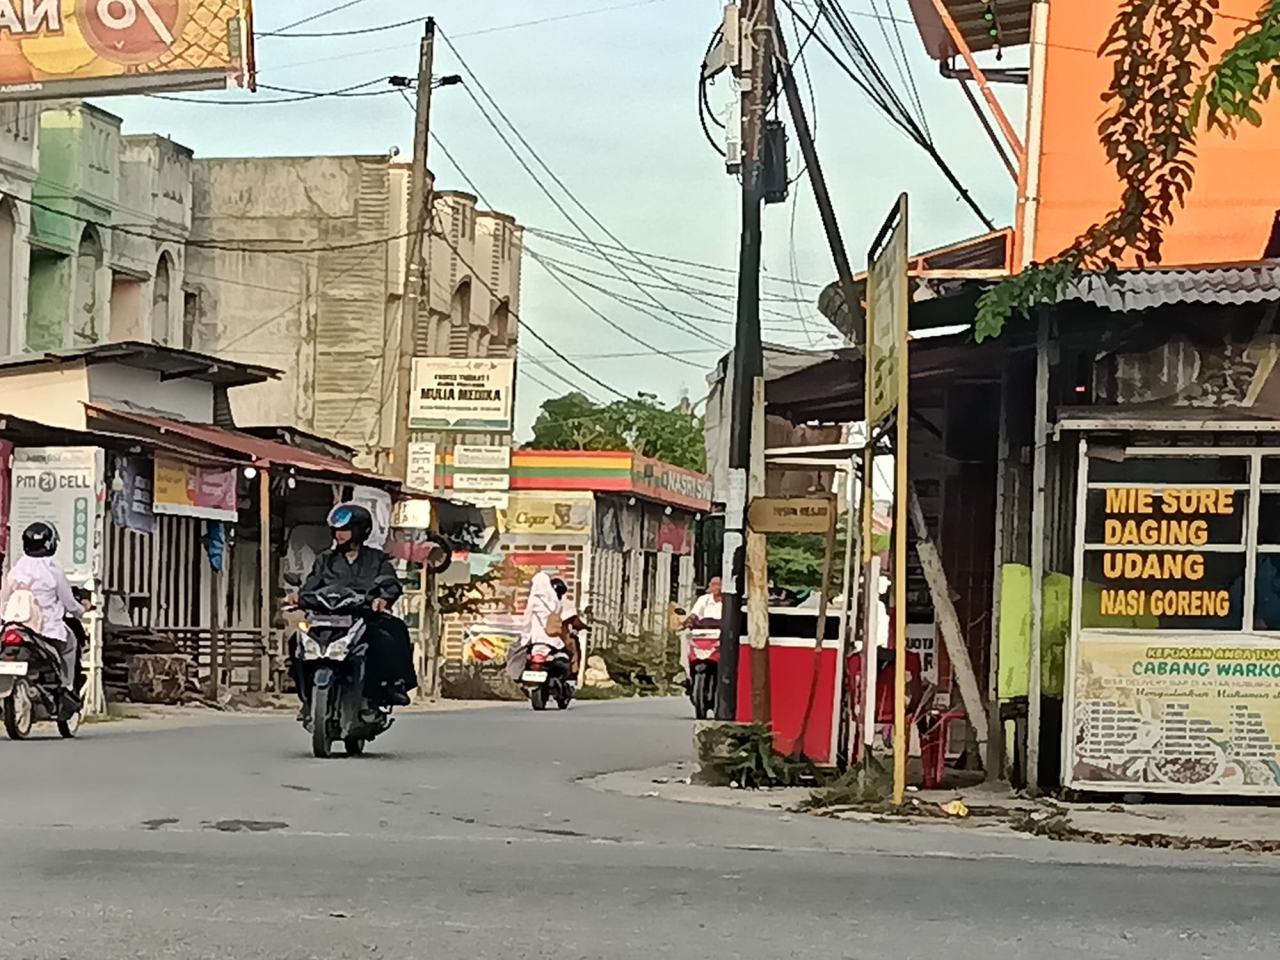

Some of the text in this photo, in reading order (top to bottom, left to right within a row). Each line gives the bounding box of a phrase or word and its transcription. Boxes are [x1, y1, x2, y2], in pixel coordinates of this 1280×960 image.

[420, 388, 455, 400] MULIA
[59, 475, 91, 489] CELL
[1105, 488, 1153, 513] MIE
[1104, 519, 1208, 545] DAGING
[1103, 554, 1205, 579] UDANG
[1100, 590, 1230, 616] NASI GORENG
[1147, 647, 1213, 660] KEPUASAN
[1132, 660, 1210, 677] CABANG
